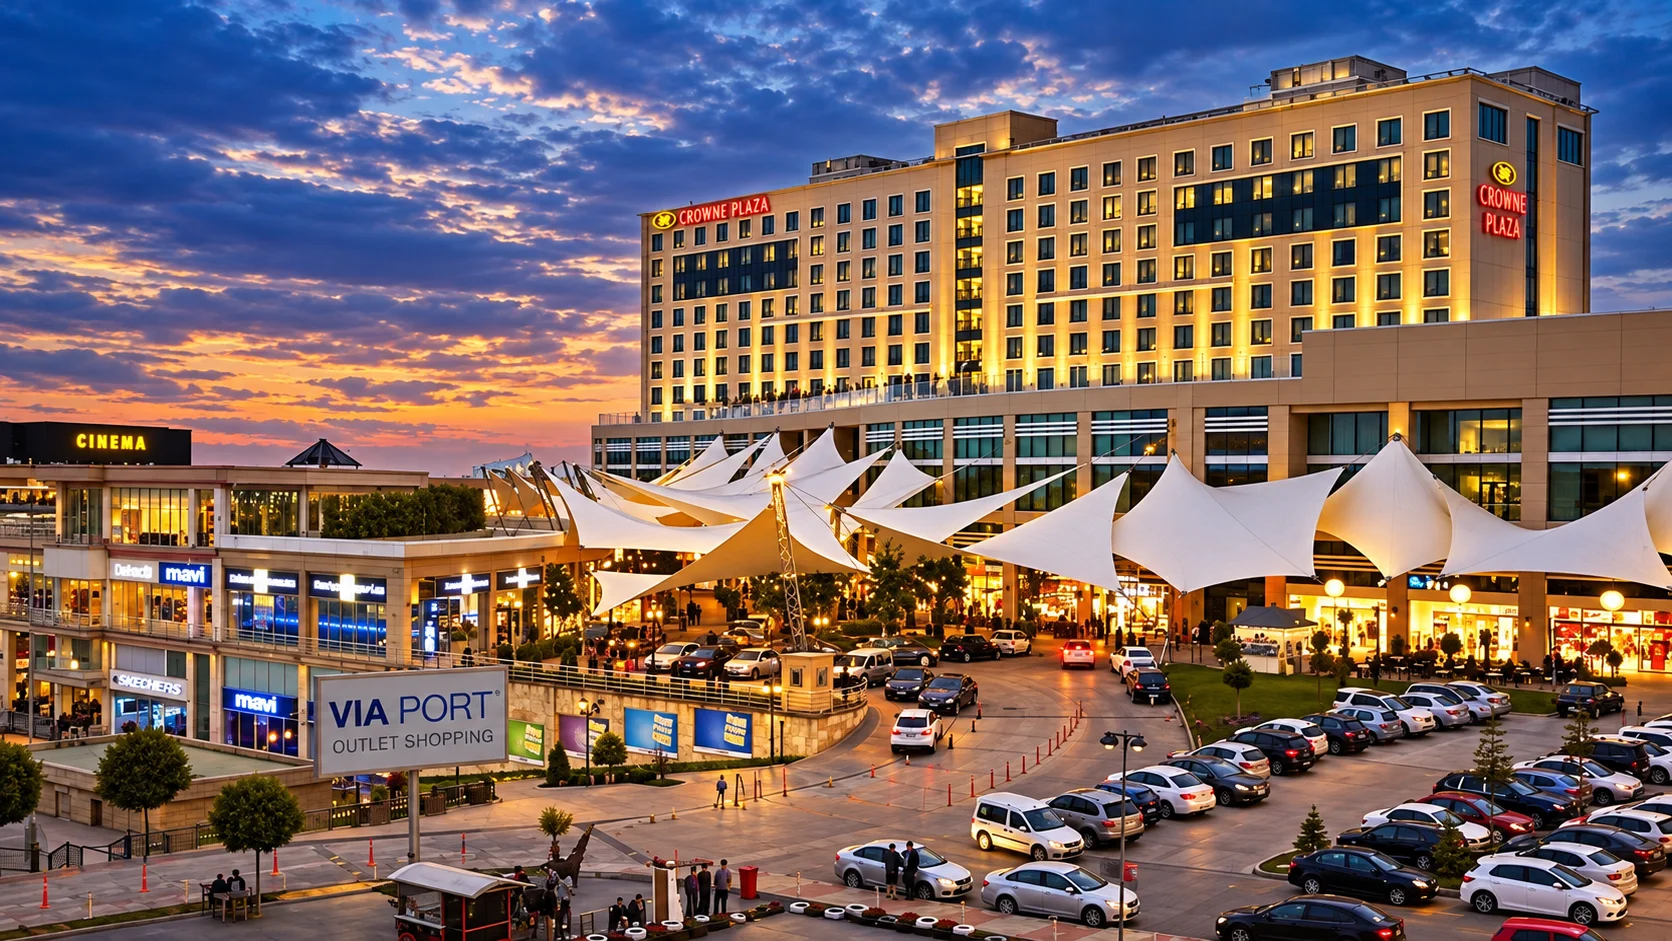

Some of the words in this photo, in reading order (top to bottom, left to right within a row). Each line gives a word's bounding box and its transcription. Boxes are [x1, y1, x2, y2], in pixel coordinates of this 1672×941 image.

[679, 203, 728, 225] CROWNE
[731, 197, 769, 217] PLAZA
[1480, 184, 1527, 214] CROWNE
[1486, 212, 1521, 238] PLAZA
[76, 433, 147, 451] CINEMA
[165, 566, 205, 584] mavi
[118, 674, 182, 695] SKECHERS
[234, 693, 277, 714] mavi
[329, 698, 389, 728] VIA
[332, 735, 399, 755] OUTLET
[404, 729, 494, 749] SHOPPING
